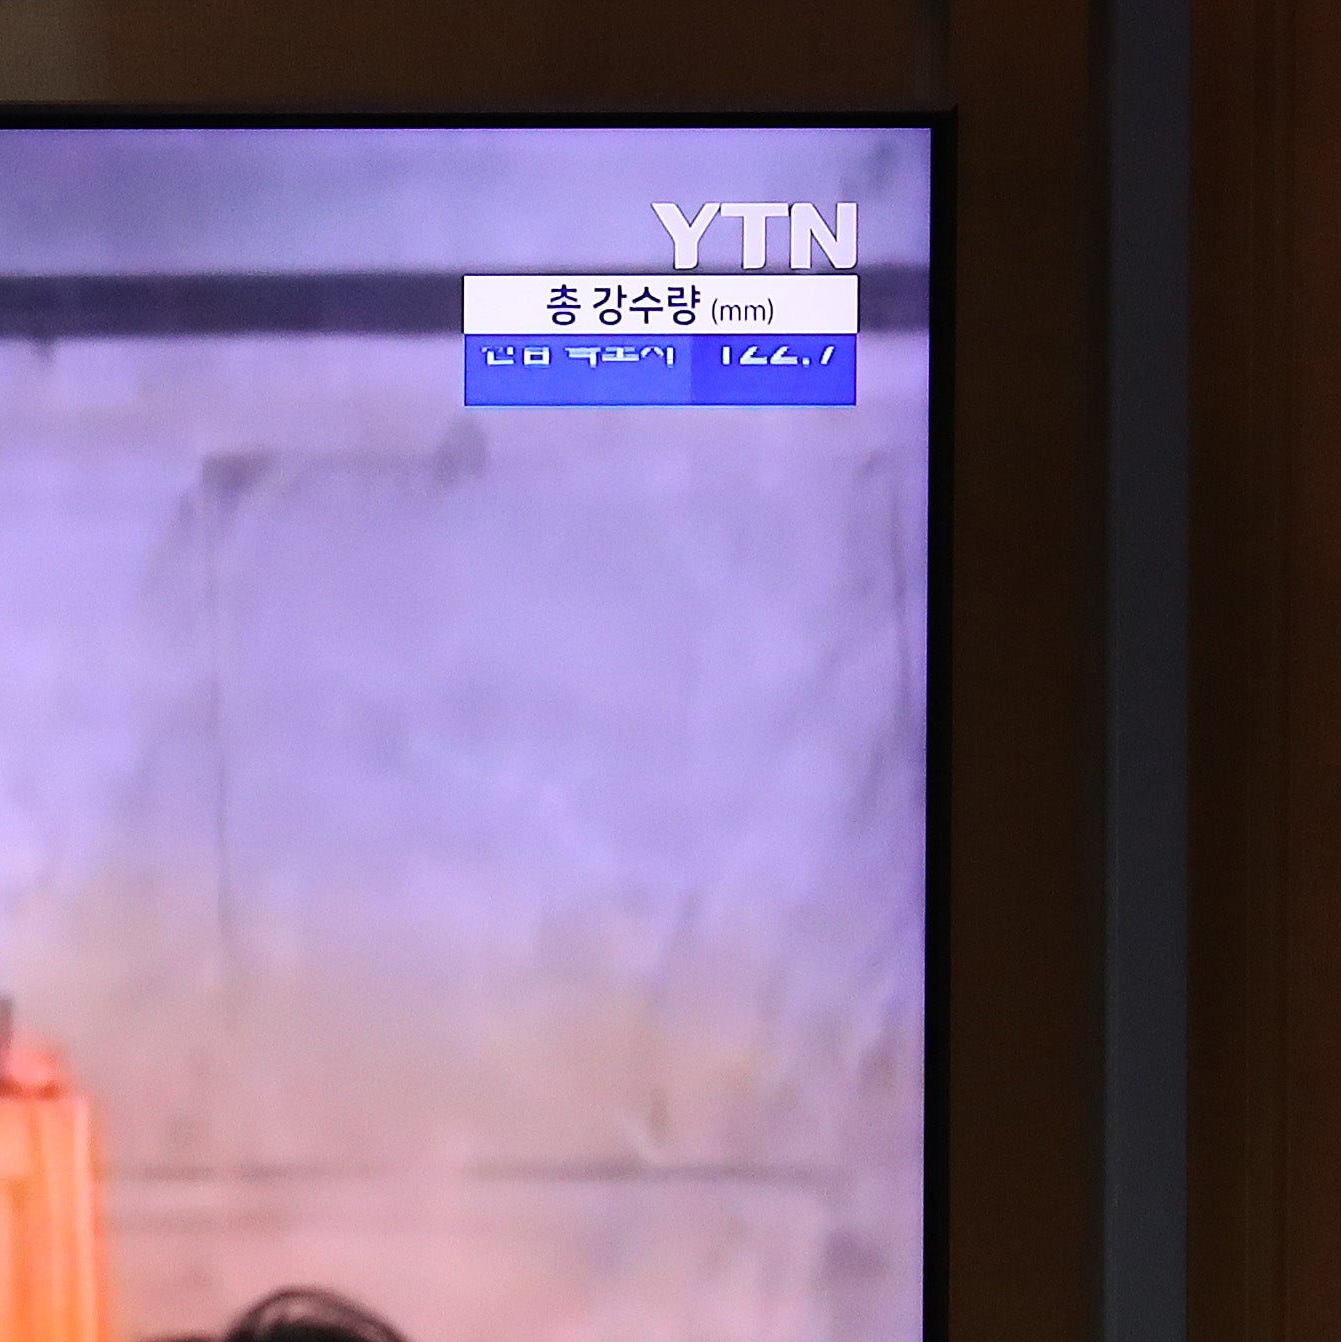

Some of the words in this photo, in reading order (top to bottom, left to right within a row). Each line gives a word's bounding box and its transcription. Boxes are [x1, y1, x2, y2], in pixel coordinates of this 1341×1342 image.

[652, 202, 857, 270] YTN
[546, 283, 582, 326] 총
[593, 284, 701, 326] 강수량
[711, 298, 774, 325] (mm)
